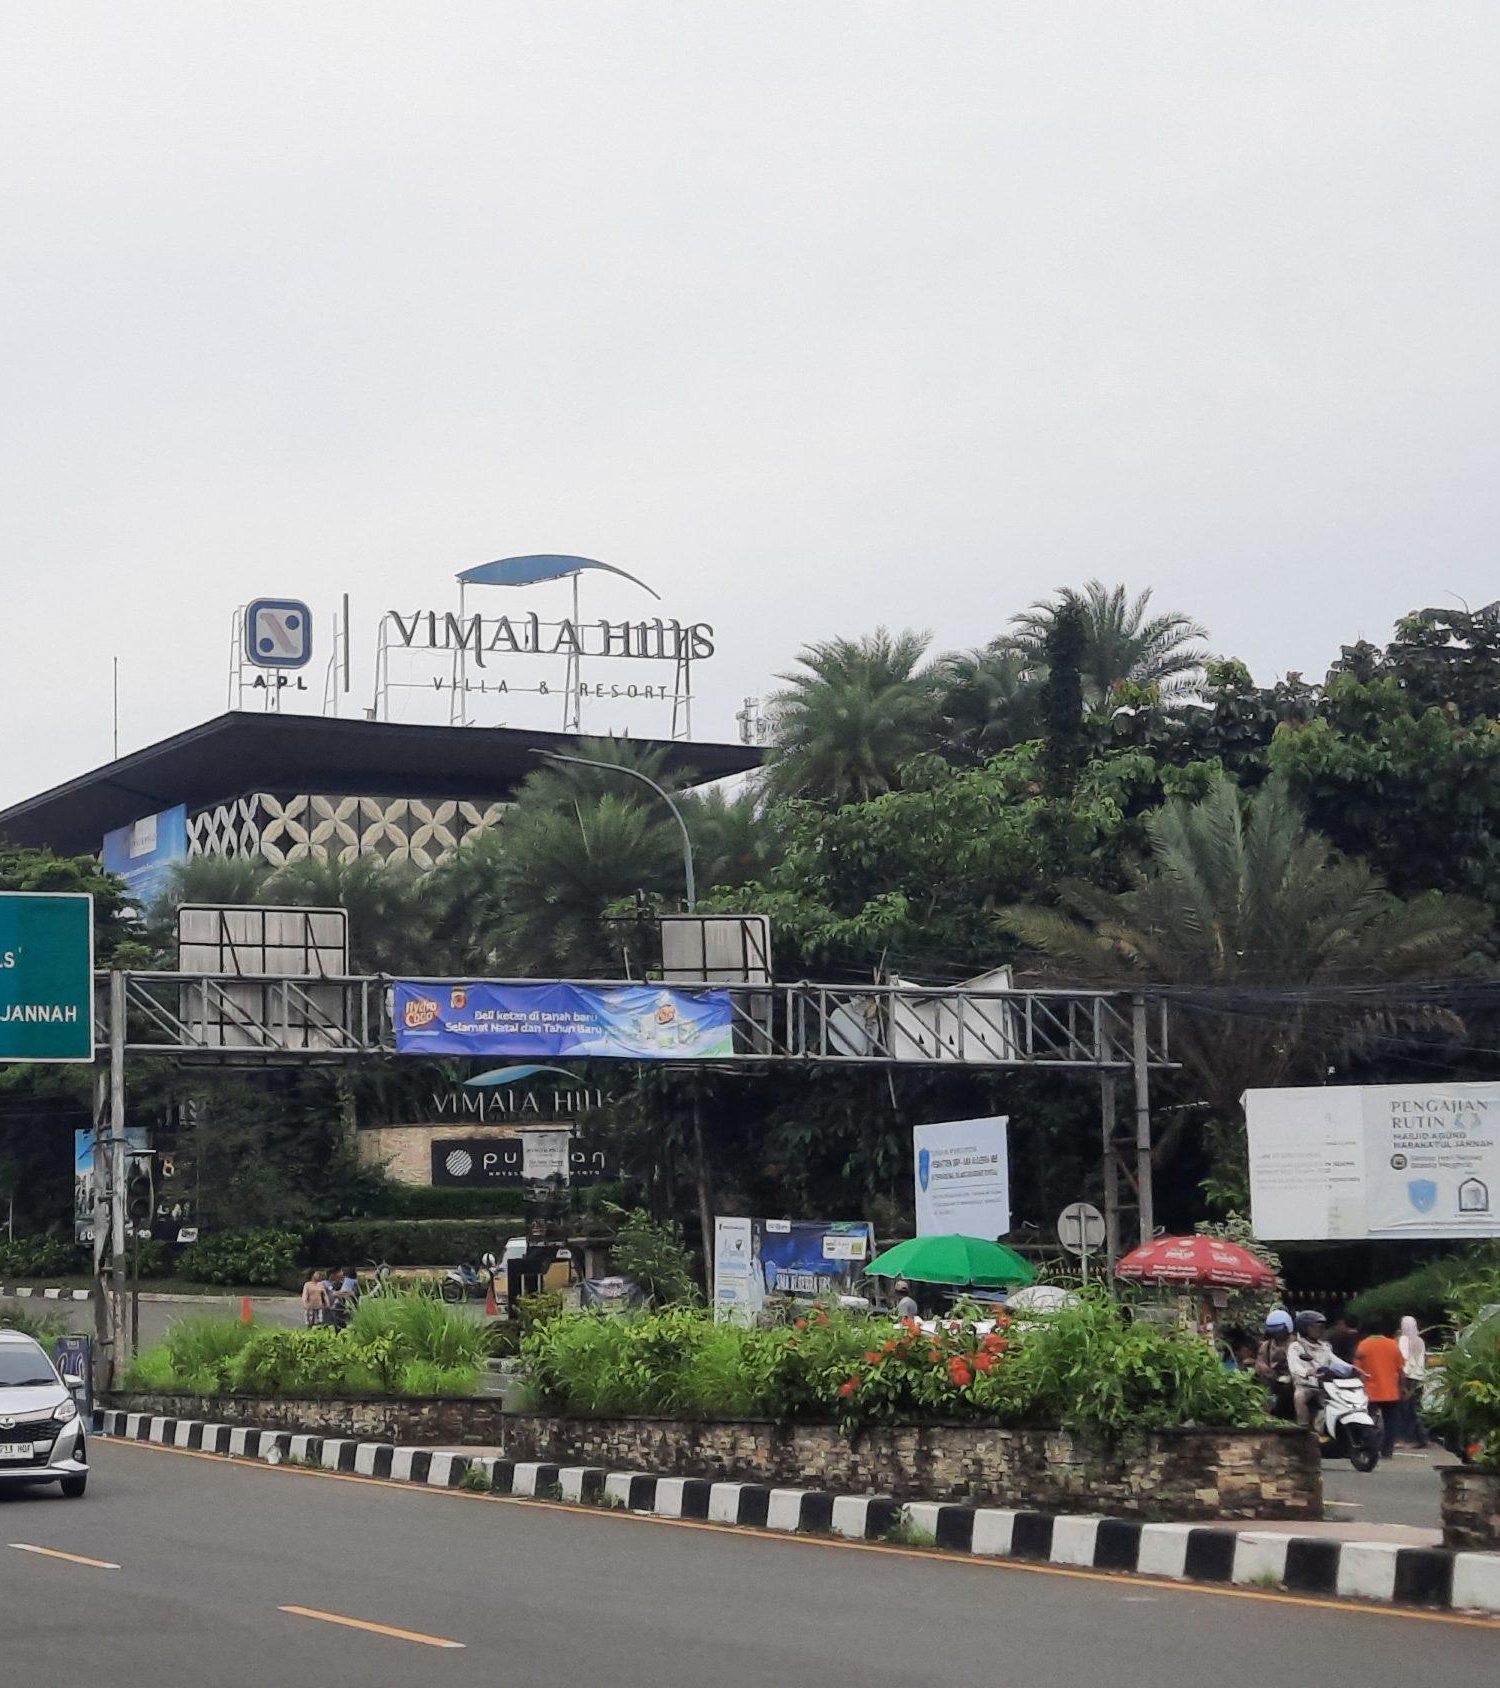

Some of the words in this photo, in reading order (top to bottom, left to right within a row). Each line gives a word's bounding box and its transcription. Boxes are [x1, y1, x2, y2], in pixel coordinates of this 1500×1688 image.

[388, 610, 582, 668] VIMALA
[433, 676, 509, 693] VILLA
[538, 681, 549, 694] &
[580, 682, 667, 699] RESORT
[0, 1005, 77, 1022] JANNAH
[474, 1010, 494, 1020] Beli
[496, 1011, 527, 1021] ketan
[528, 1010, 540, 1021] di
[541, 1011, 571, 1021] tanah
[573, 1011, 598, 1021] baru
[445, 1022, 489, 1032] Selamat
[490, 1023, 519, 1033] Natal
[520, 1023, 542, 1033] dan
[543, 1024, 576, 1034] Tahun
[433, 1089, 540, 1122] VIMALA
[1391, 1100, 1488, 1113] PENGAJIAN
[1392, 1116, 1445, 1129] RUTIN
[1393, 1132, 1430, 1140] MASJID
